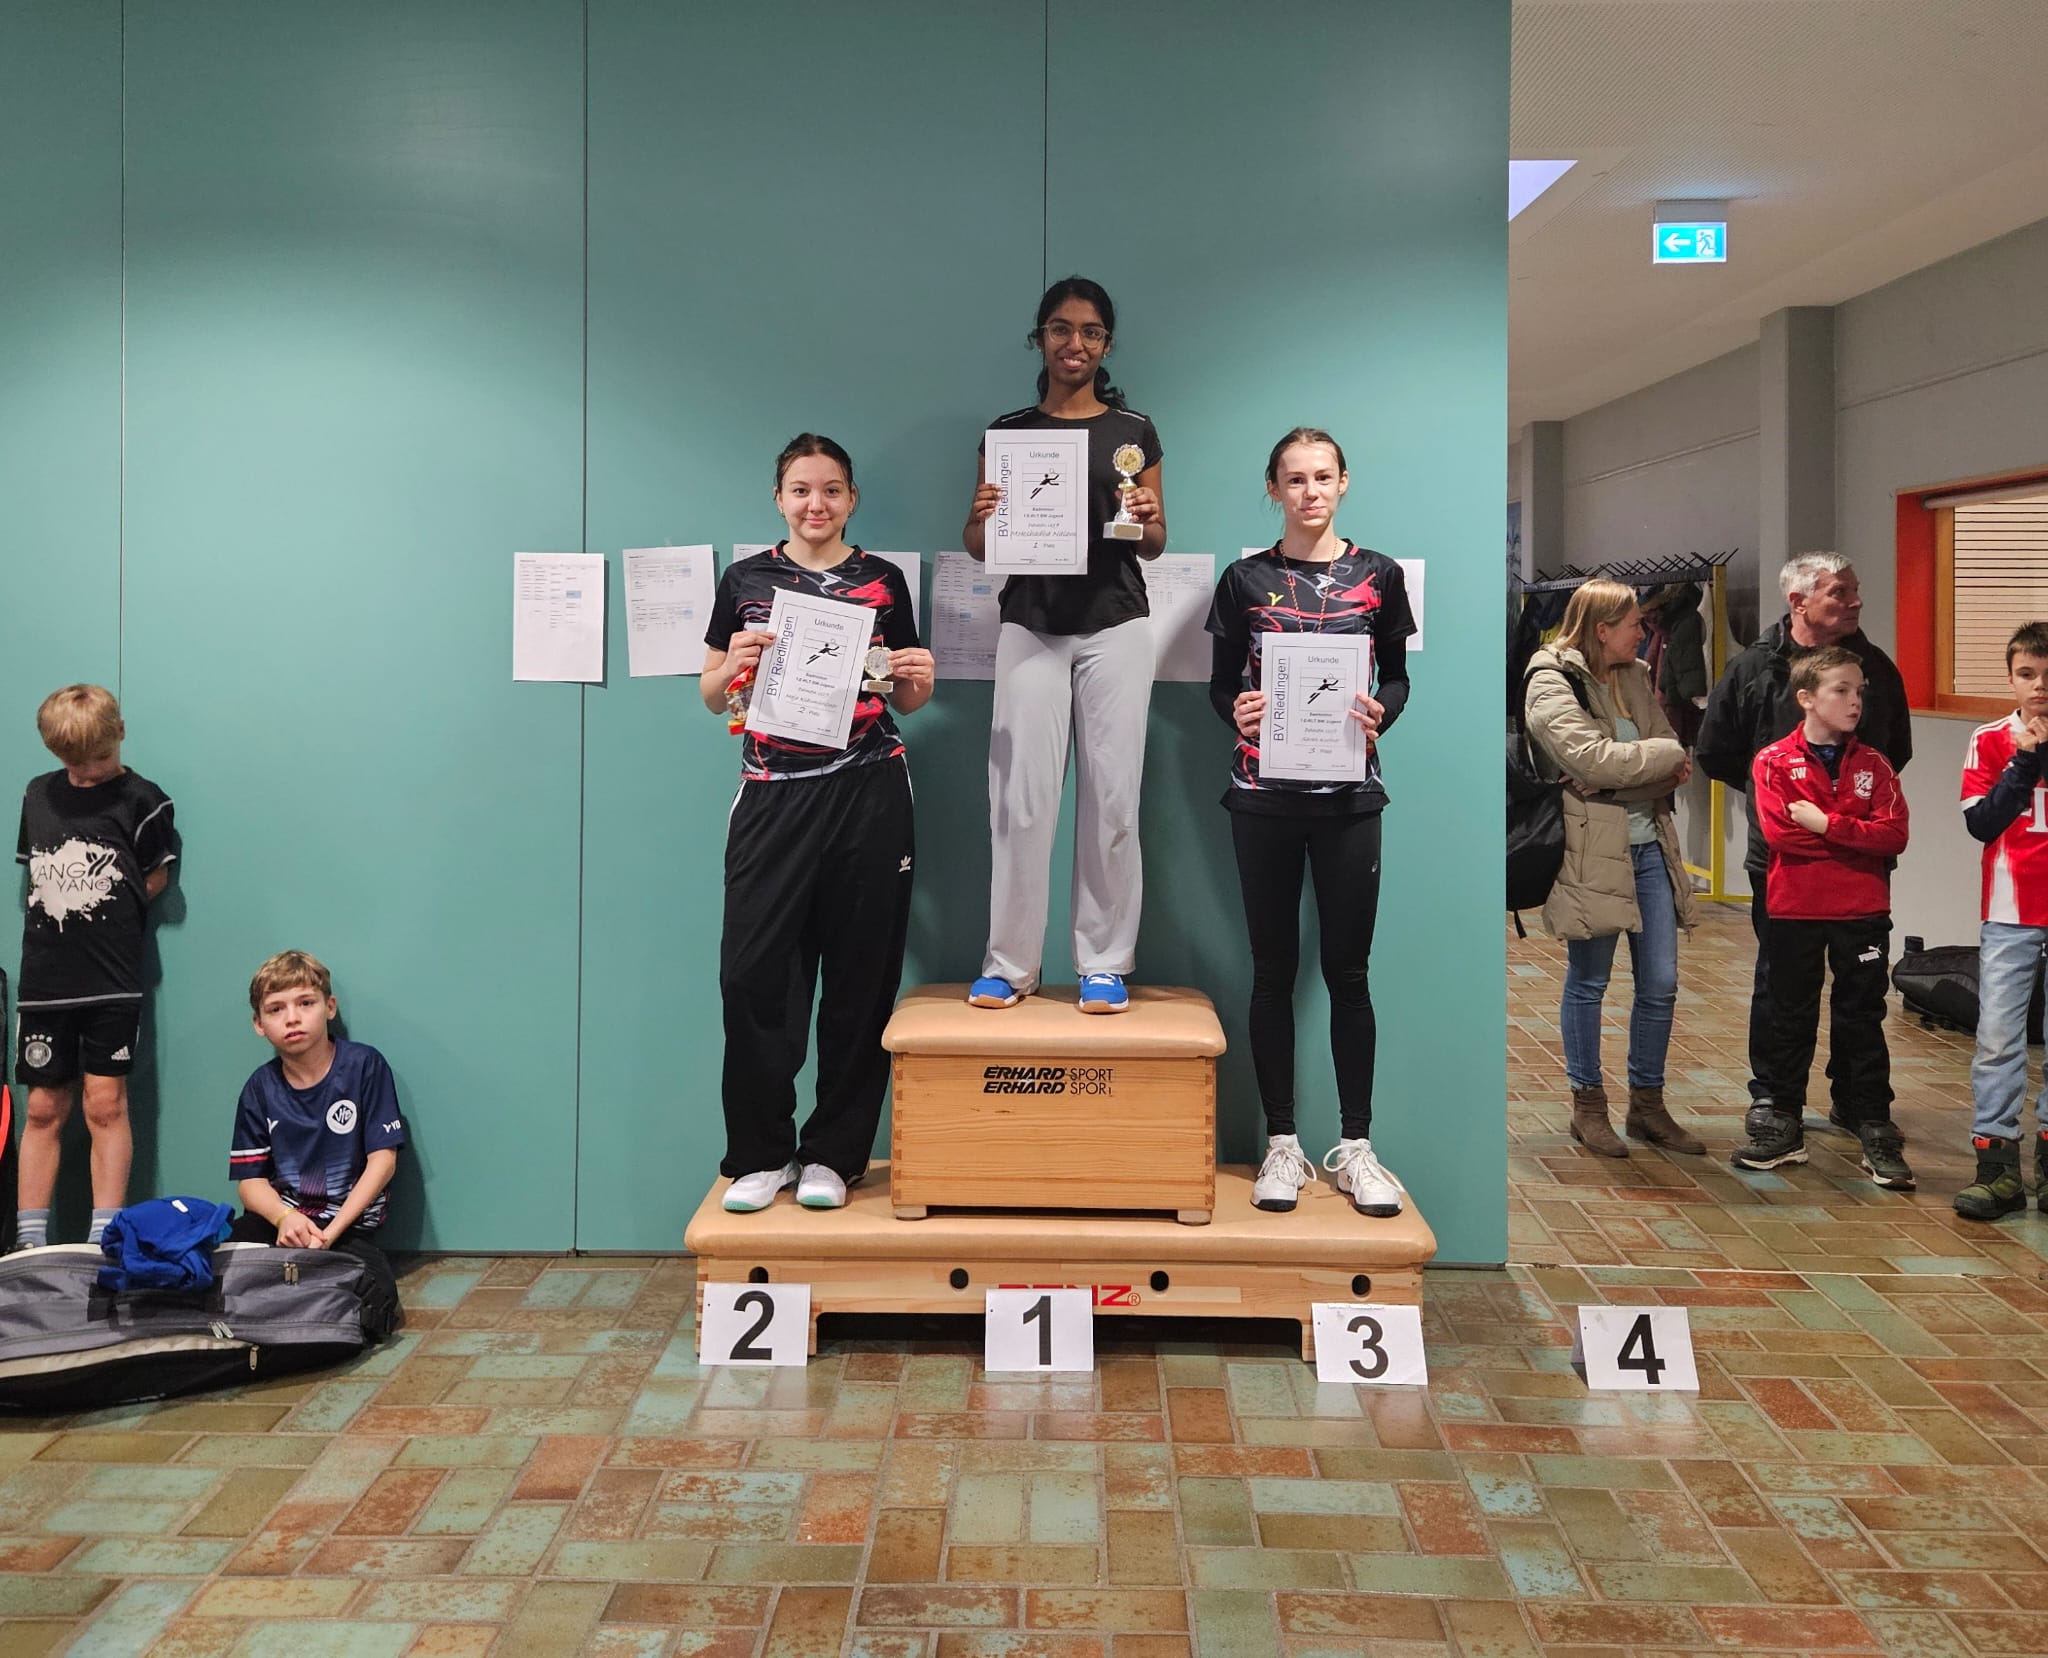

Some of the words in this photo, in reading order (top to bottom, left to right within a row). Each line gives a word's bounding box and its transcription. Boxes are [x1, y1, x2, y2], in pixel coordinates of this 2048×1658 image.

[1029, 451, 1060, 459] Urkunde
[998, 520, 1009, 537] BV
[814, 617, 844, 631] Urkunde
[771, 616, 795, 676] Riedlingen
[1308, 655, 1339, 664] Urkunde
[766, 677, 777, 697] BV
[1273, 658, 1289, 720] Riedlingen
[1273, 723, 1284, 741] BV
[1790, 767, 1807, 780] JW
[983, 1066, 1067, 1081] ERHARD
[1070, 1068, 1113, 1081] SPORT
[983, 1081, 1067, 1095] ERHARD
[729, 1290, 775, 1361] 2
[1023, 1295, 1052, 1366] 1
[1346, 1315, 1389, 1379] 3
[1616, 1314, 1666, 1385] 4
